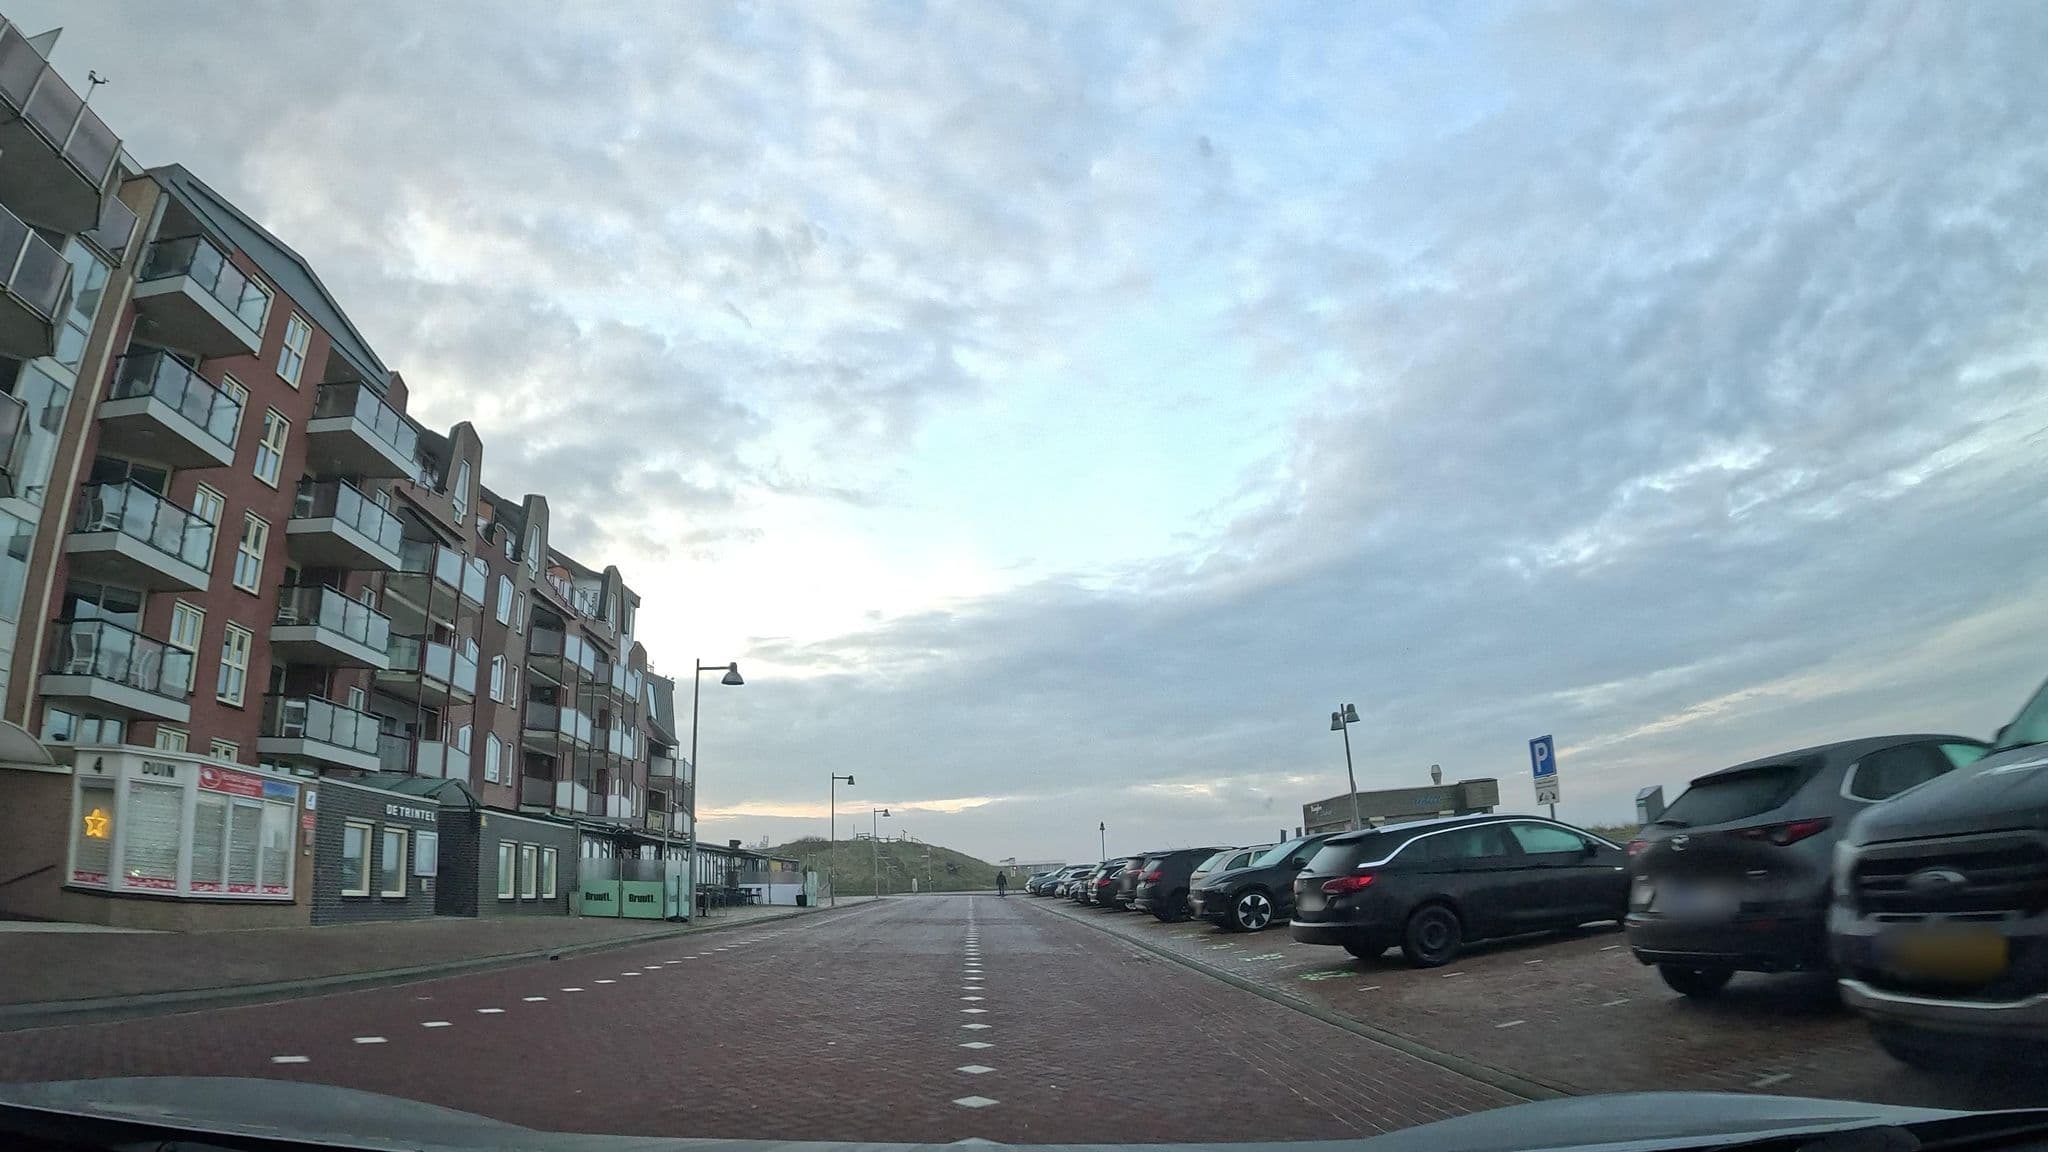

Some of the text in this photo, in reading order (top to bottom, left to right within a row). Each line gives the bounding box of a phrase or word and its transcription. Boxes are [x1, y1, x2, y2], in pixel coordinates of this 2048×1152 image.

[93, 756, 103, 774] 4
[1535, 742, 1548, 773] P
[142, 760, 176, 778] DUIN
[386, 804, 398, 816] DE
